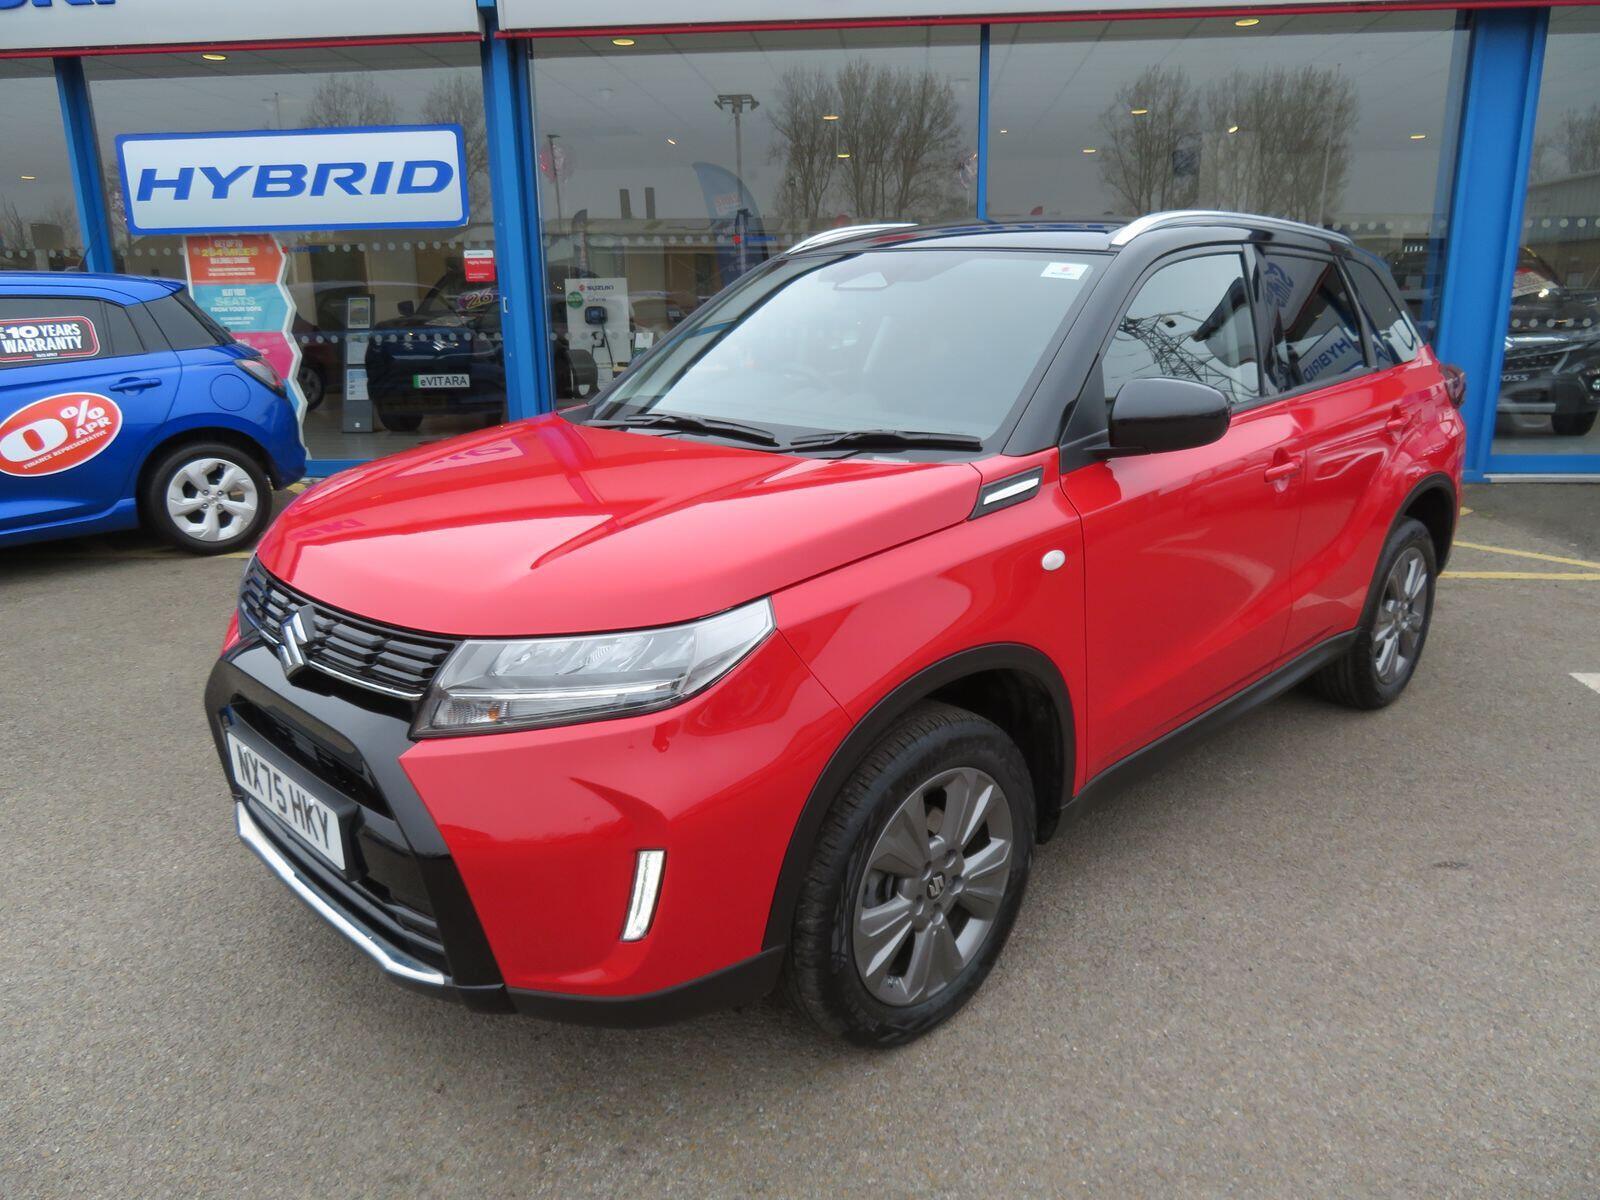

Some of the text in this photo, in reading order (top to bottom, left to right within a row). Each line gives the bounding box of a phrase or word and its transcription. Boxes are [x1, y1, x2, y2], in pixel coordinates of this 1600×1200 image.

[136, 160, 454, 201] HYBRID
[215, 297, 256, 306] SEATS
[6, 326, 39, 338] 10
[39, 323, 81, 336] YEARS
[2, 336, 82, 353] WARRANTY
[420, 376, 467, 386] eVITARA
[75, 416, 113, 439] APR
[23, 430, 107, 469] FINANCE REPRESENTATIVE
[237, 744, 329, 850] NX75 HKY
